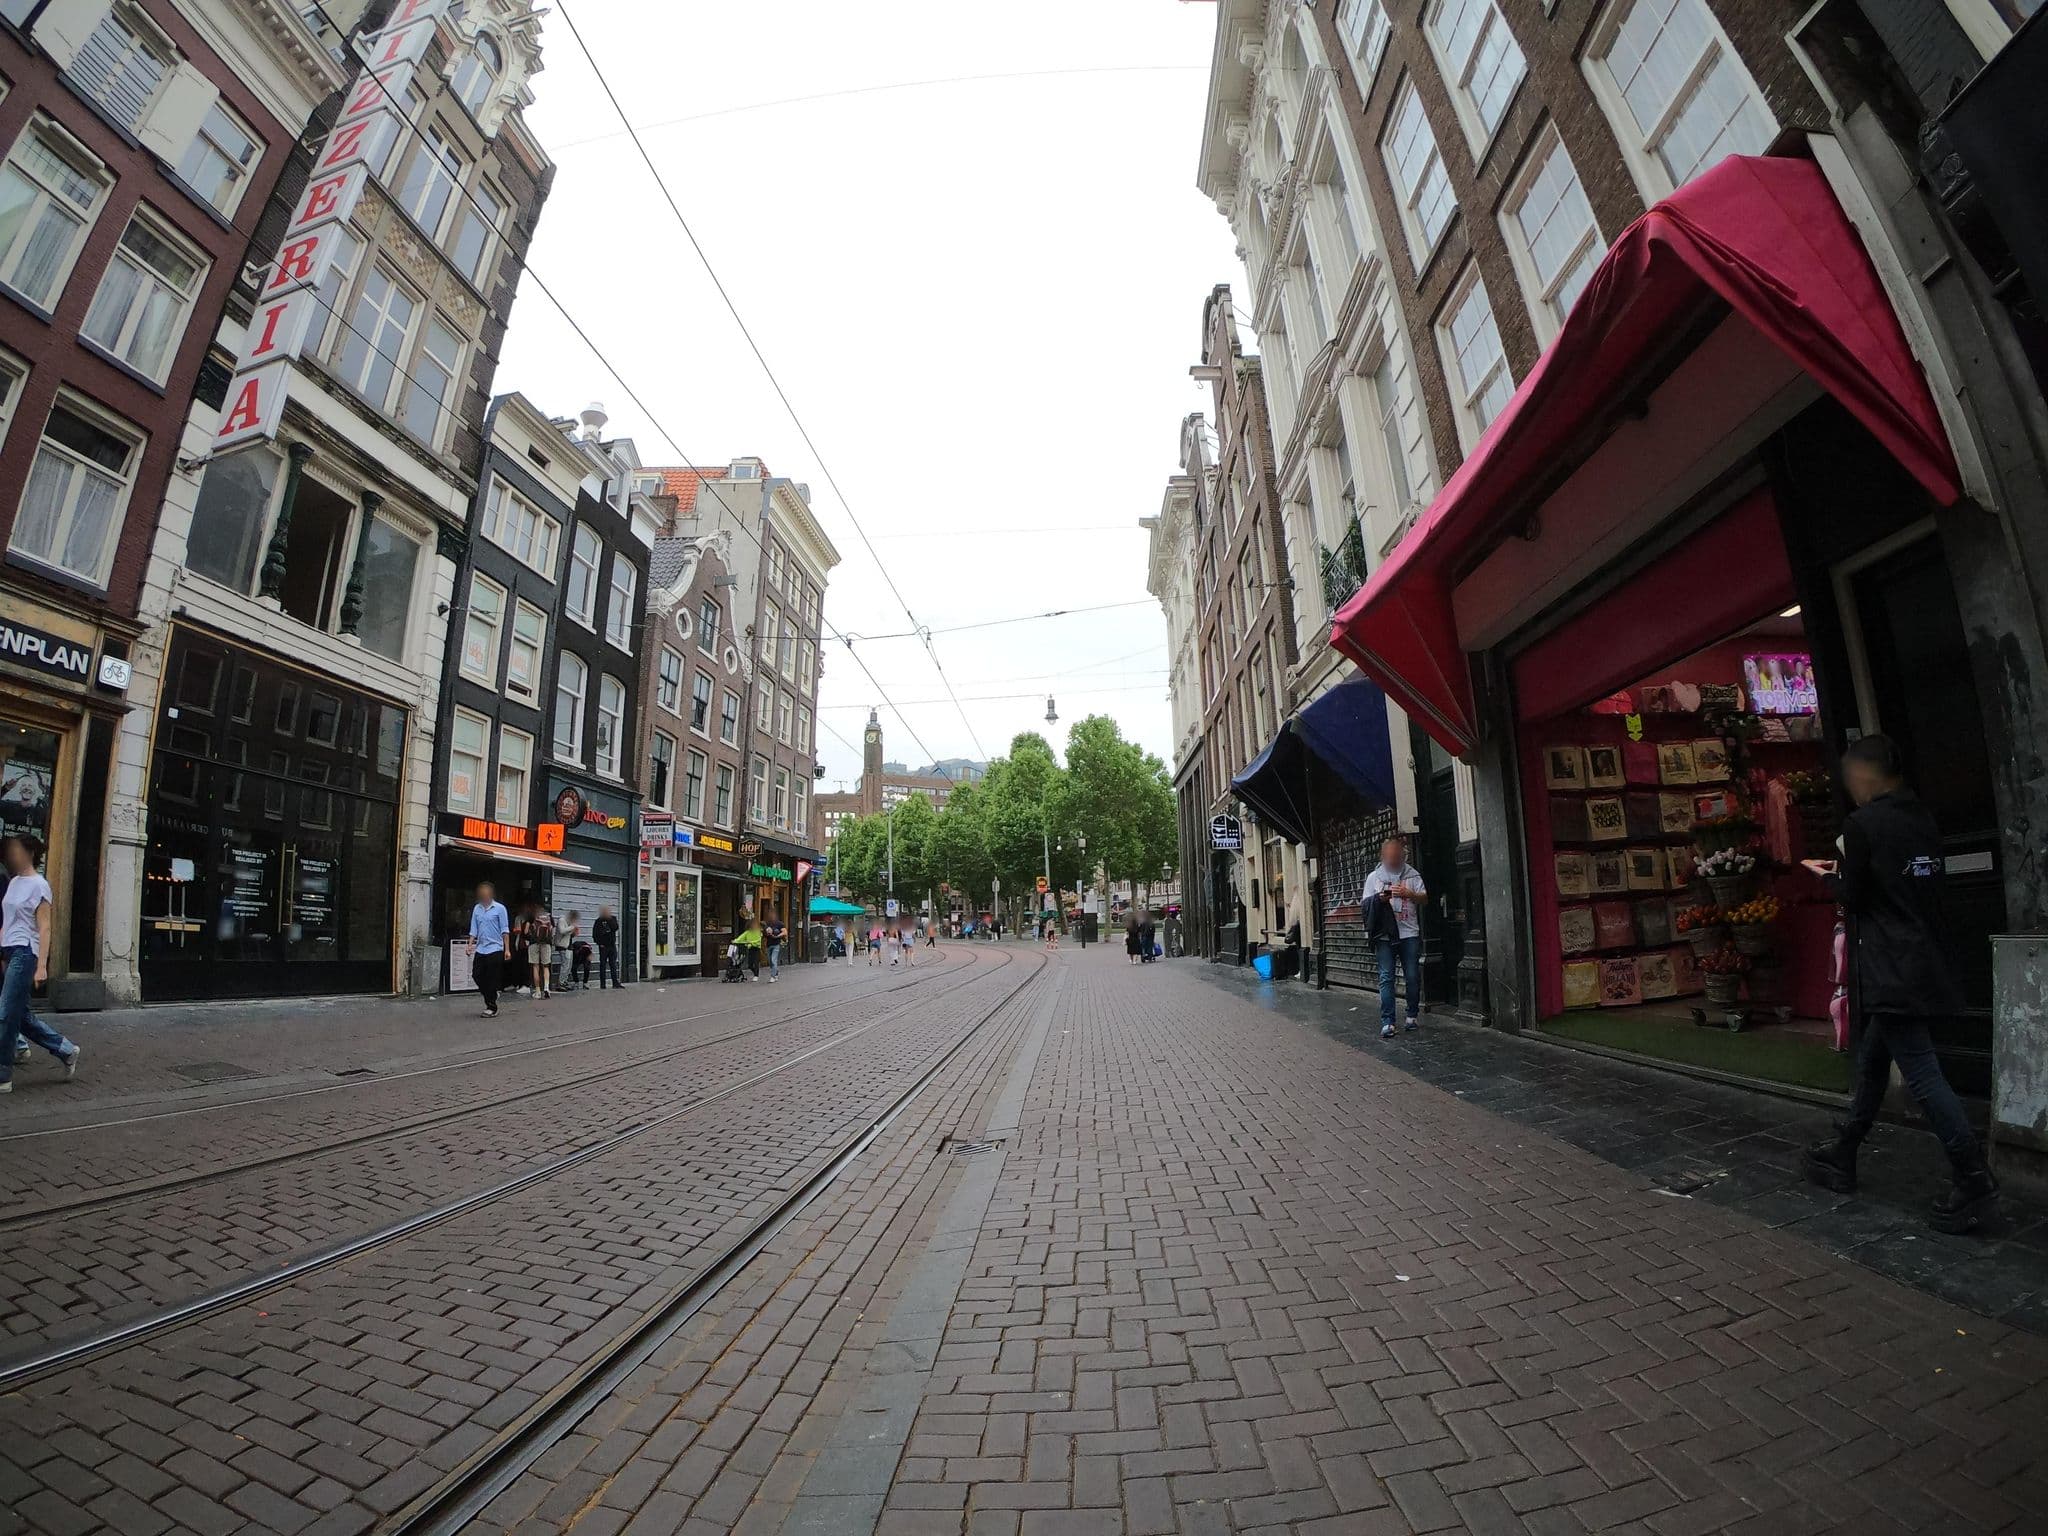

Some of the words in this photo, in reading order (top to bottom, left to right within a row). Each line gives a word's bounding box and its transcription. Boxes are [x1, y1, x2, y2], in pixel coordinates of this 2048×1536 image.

[5, 823, 16, 831] WE
[17, 824, 31, 833] ARE
[463, 817, 487, 840] WOK
[488, 822, 500, 842] TO
[500, 825, 526, 846] WALK
[741, 843, 760, 852] HOF
[752, 863, 765, 876] NEW
[779, 868, 792, 881] PIZZA
